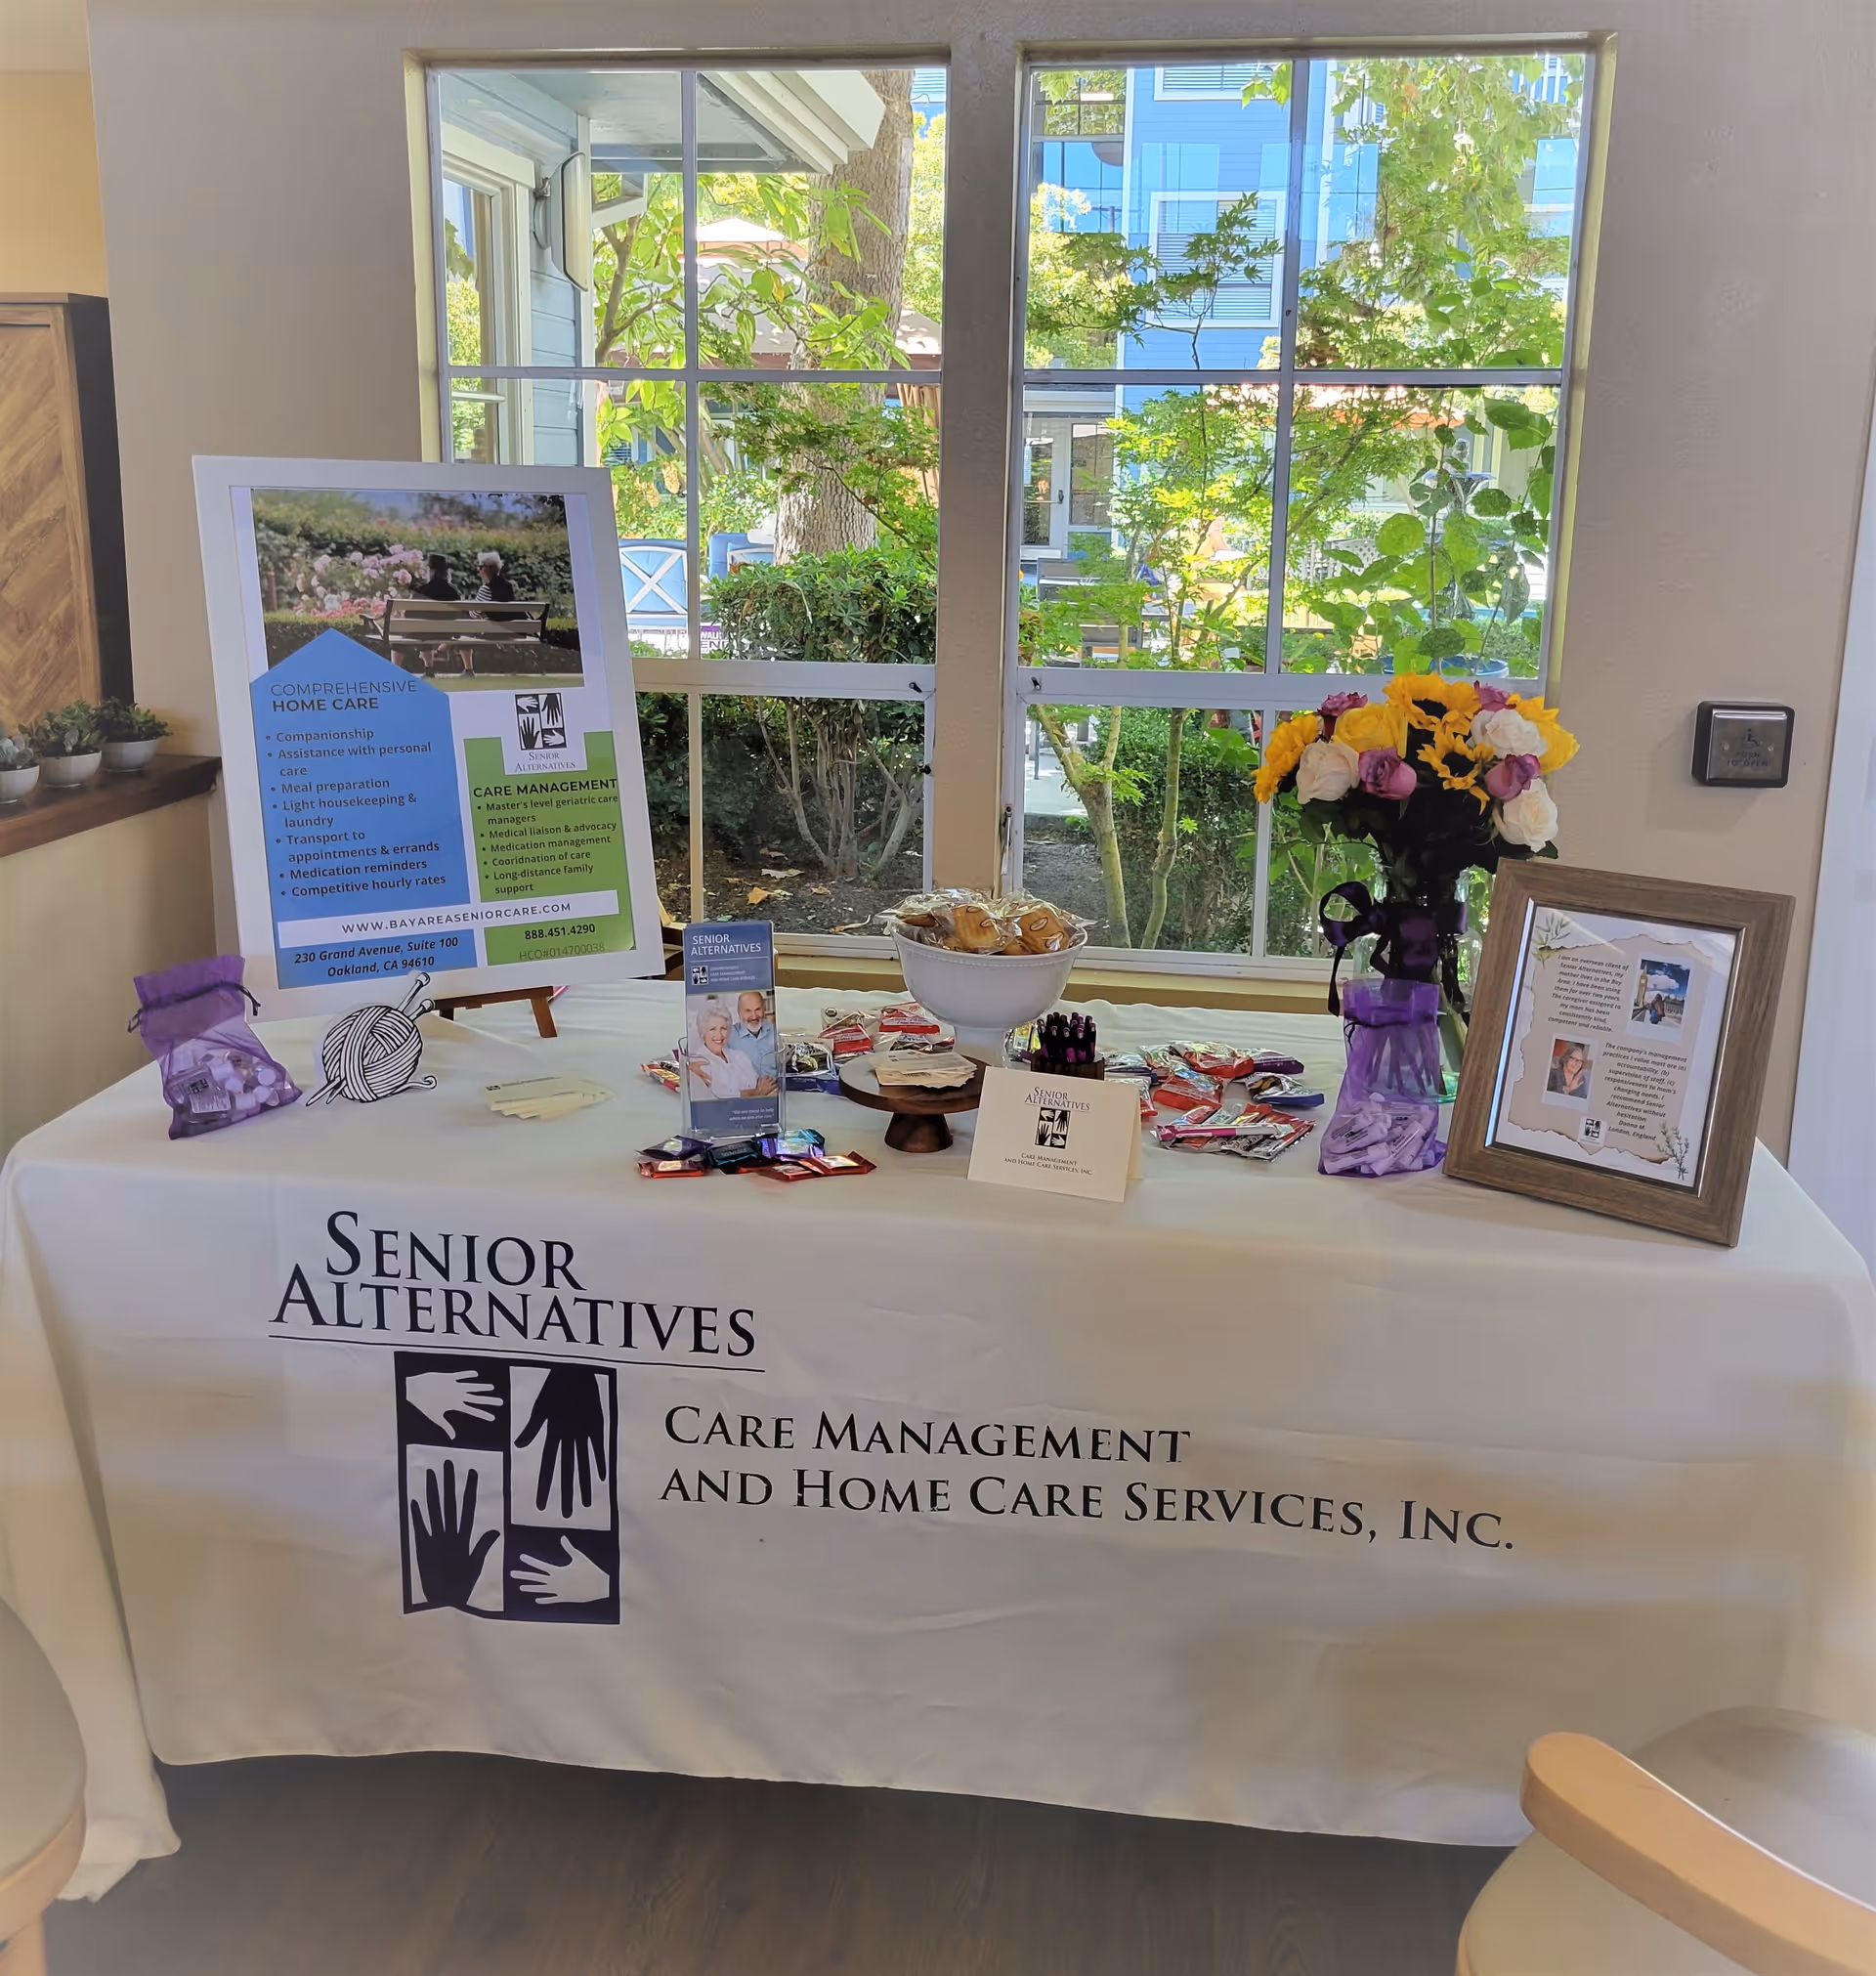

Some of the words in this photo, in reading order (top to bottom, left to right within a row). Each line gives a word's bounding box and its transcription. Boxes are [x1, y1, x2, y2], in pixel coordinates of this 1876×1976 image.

[271, 680, 416, 696] COMPREHENSIVE
[273, 699, 326, 711] HOME
[332, 697, 378, 709] CARE
[277, 728, 374, 744] Companionship
[278, 748, 344, 759] Assistance
[348, 745, 375, 755] with
[379, 742, 431, 756] personal
[529, 752, 559, 761] SENIOR
[279, 766, 308, 776] care
[515, 761, 576, 772] ALTERNATIVES
[281, 782, 313, 794] Meal
[317, 779, 390, 794] preparation
[473, 786, 512, 797] CARE
[517, 779, 617, 795] MANAGEMENT
[282, 799, 316, 812] Light
[319, 793, 405, 808] housekeeping
[408, 794, 416, 802] &
[486, 801, 528, 811] Master's
[530, 799, 553, 808] level
[555, 795, 596, 808] geriatric
[598, 795, 618, 803] care
[284, 816, 334, 828] laundry
[488, 815, 535, 825] managers
[490, 825, 527, 839] Medical
[530, 825, 561, 836] liaison
[574, 822, 617, 832] advocacy
[286, 832, 349, 845] Transport
[490, 840, 545, 853] Medication
[548, 836, 611, 847] management
[288, 847, 377, 863] appointments
[380, 845, 389, 855] &
[393, 841, 440, 853] errands
[559, 850, 568, 860] of
[571, 850, 591, 859] care
[290, 865, 361, 880] Medication
[364, 859, 427, 874] reminders
[493, 865, 561, 881] Long-distance
[564, 864, 594, 875] family
[292, 881, 369, 897] Competitive
[372, 877, 411, 890] hourly
[415, 875, 446, 885] rates
[495, 883, 534, 895] support
[342, 903, 572, 934] WWW.BAYAREASENIORCARE.COM
[525, 924, 595, 939] 888.451.4290
[693, 934, 730, 945] SENIOR
[294, 952, 316, 964] 230
[320, 947, 357, 962] Grand
[359, 943, 404, 959] Avenue,
[407, 938, 436, 951] Suite
[439, 937, 458, 948] 100
[520, 942, 605, 961] HCO#014700038
[691, 942, 761, 957] ALTERNATIVES
[327, 962, 379, 977] Oakland,
[383, 960, 399, 970] CA
[401, 956, 435, 968] 94610
[1559, 1011, 1593, 1021] consistently
[1648, 1051, 1687, 1062] management
[1608, 1069, 1642, 1079] supervision
[1604, 1076, 1648, 1089] responsiveness
[1034, 1087, 1068, 1100] SENIOR
[1614, 1087, 1640, 1096] changing
[1025, 1094, 1090, 1111] ALTERNATIVES
[1606, 1101, 1642, 1112] Alternatives
[1610, 1095, 1645, 1104] recommend
[1633, 1132, 1656, 1140] England
[1038, 1155, 1077, 1166] MANAGEMENT
[325, 1210, 586, 1291] SENIOR
[269, 1263, 755, 1357] ALTERNATIVES
[663, 1404, 795, 1449] CARE
[812, 1413, 1191, 1465] MANAGEMENT
[659, 1469, 774, 1507] AND
[791, 1468, 953, 1516] HOME
[968, 1477, 1104, 1522] CARE
[1124, 1481, 1379, 1545] SERVICES,
[1398, 1499, 1515, 1551] INC.
